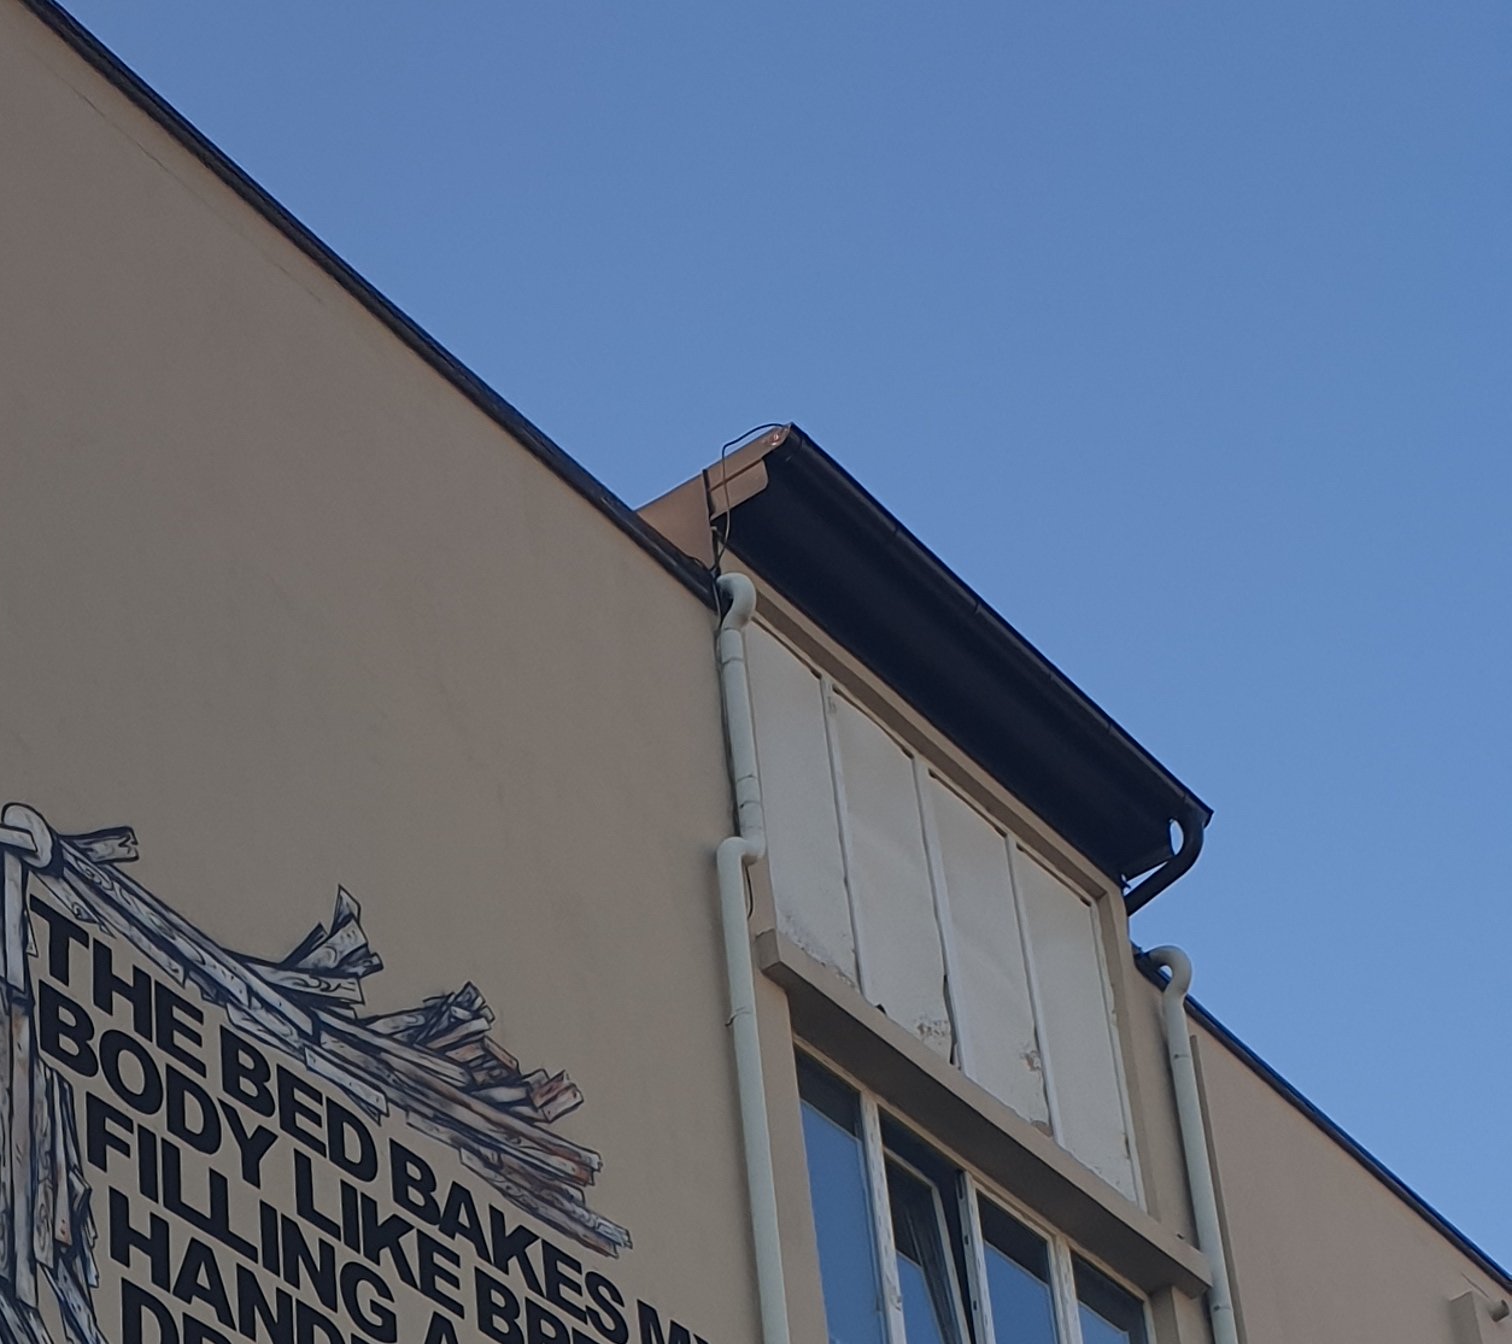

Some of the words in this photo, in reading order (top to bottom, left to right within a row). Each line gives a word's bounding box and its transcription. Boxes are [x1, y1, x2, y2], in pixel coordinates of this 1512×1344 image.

[29, 893, 207, 1079] THE
[219, 1024, 379, 1183] BED
[38, 978, 279, 1190] BODY
[293, 1147, 465, 1320] LIKE
[85, 1090, 398, 1344] FILLING
